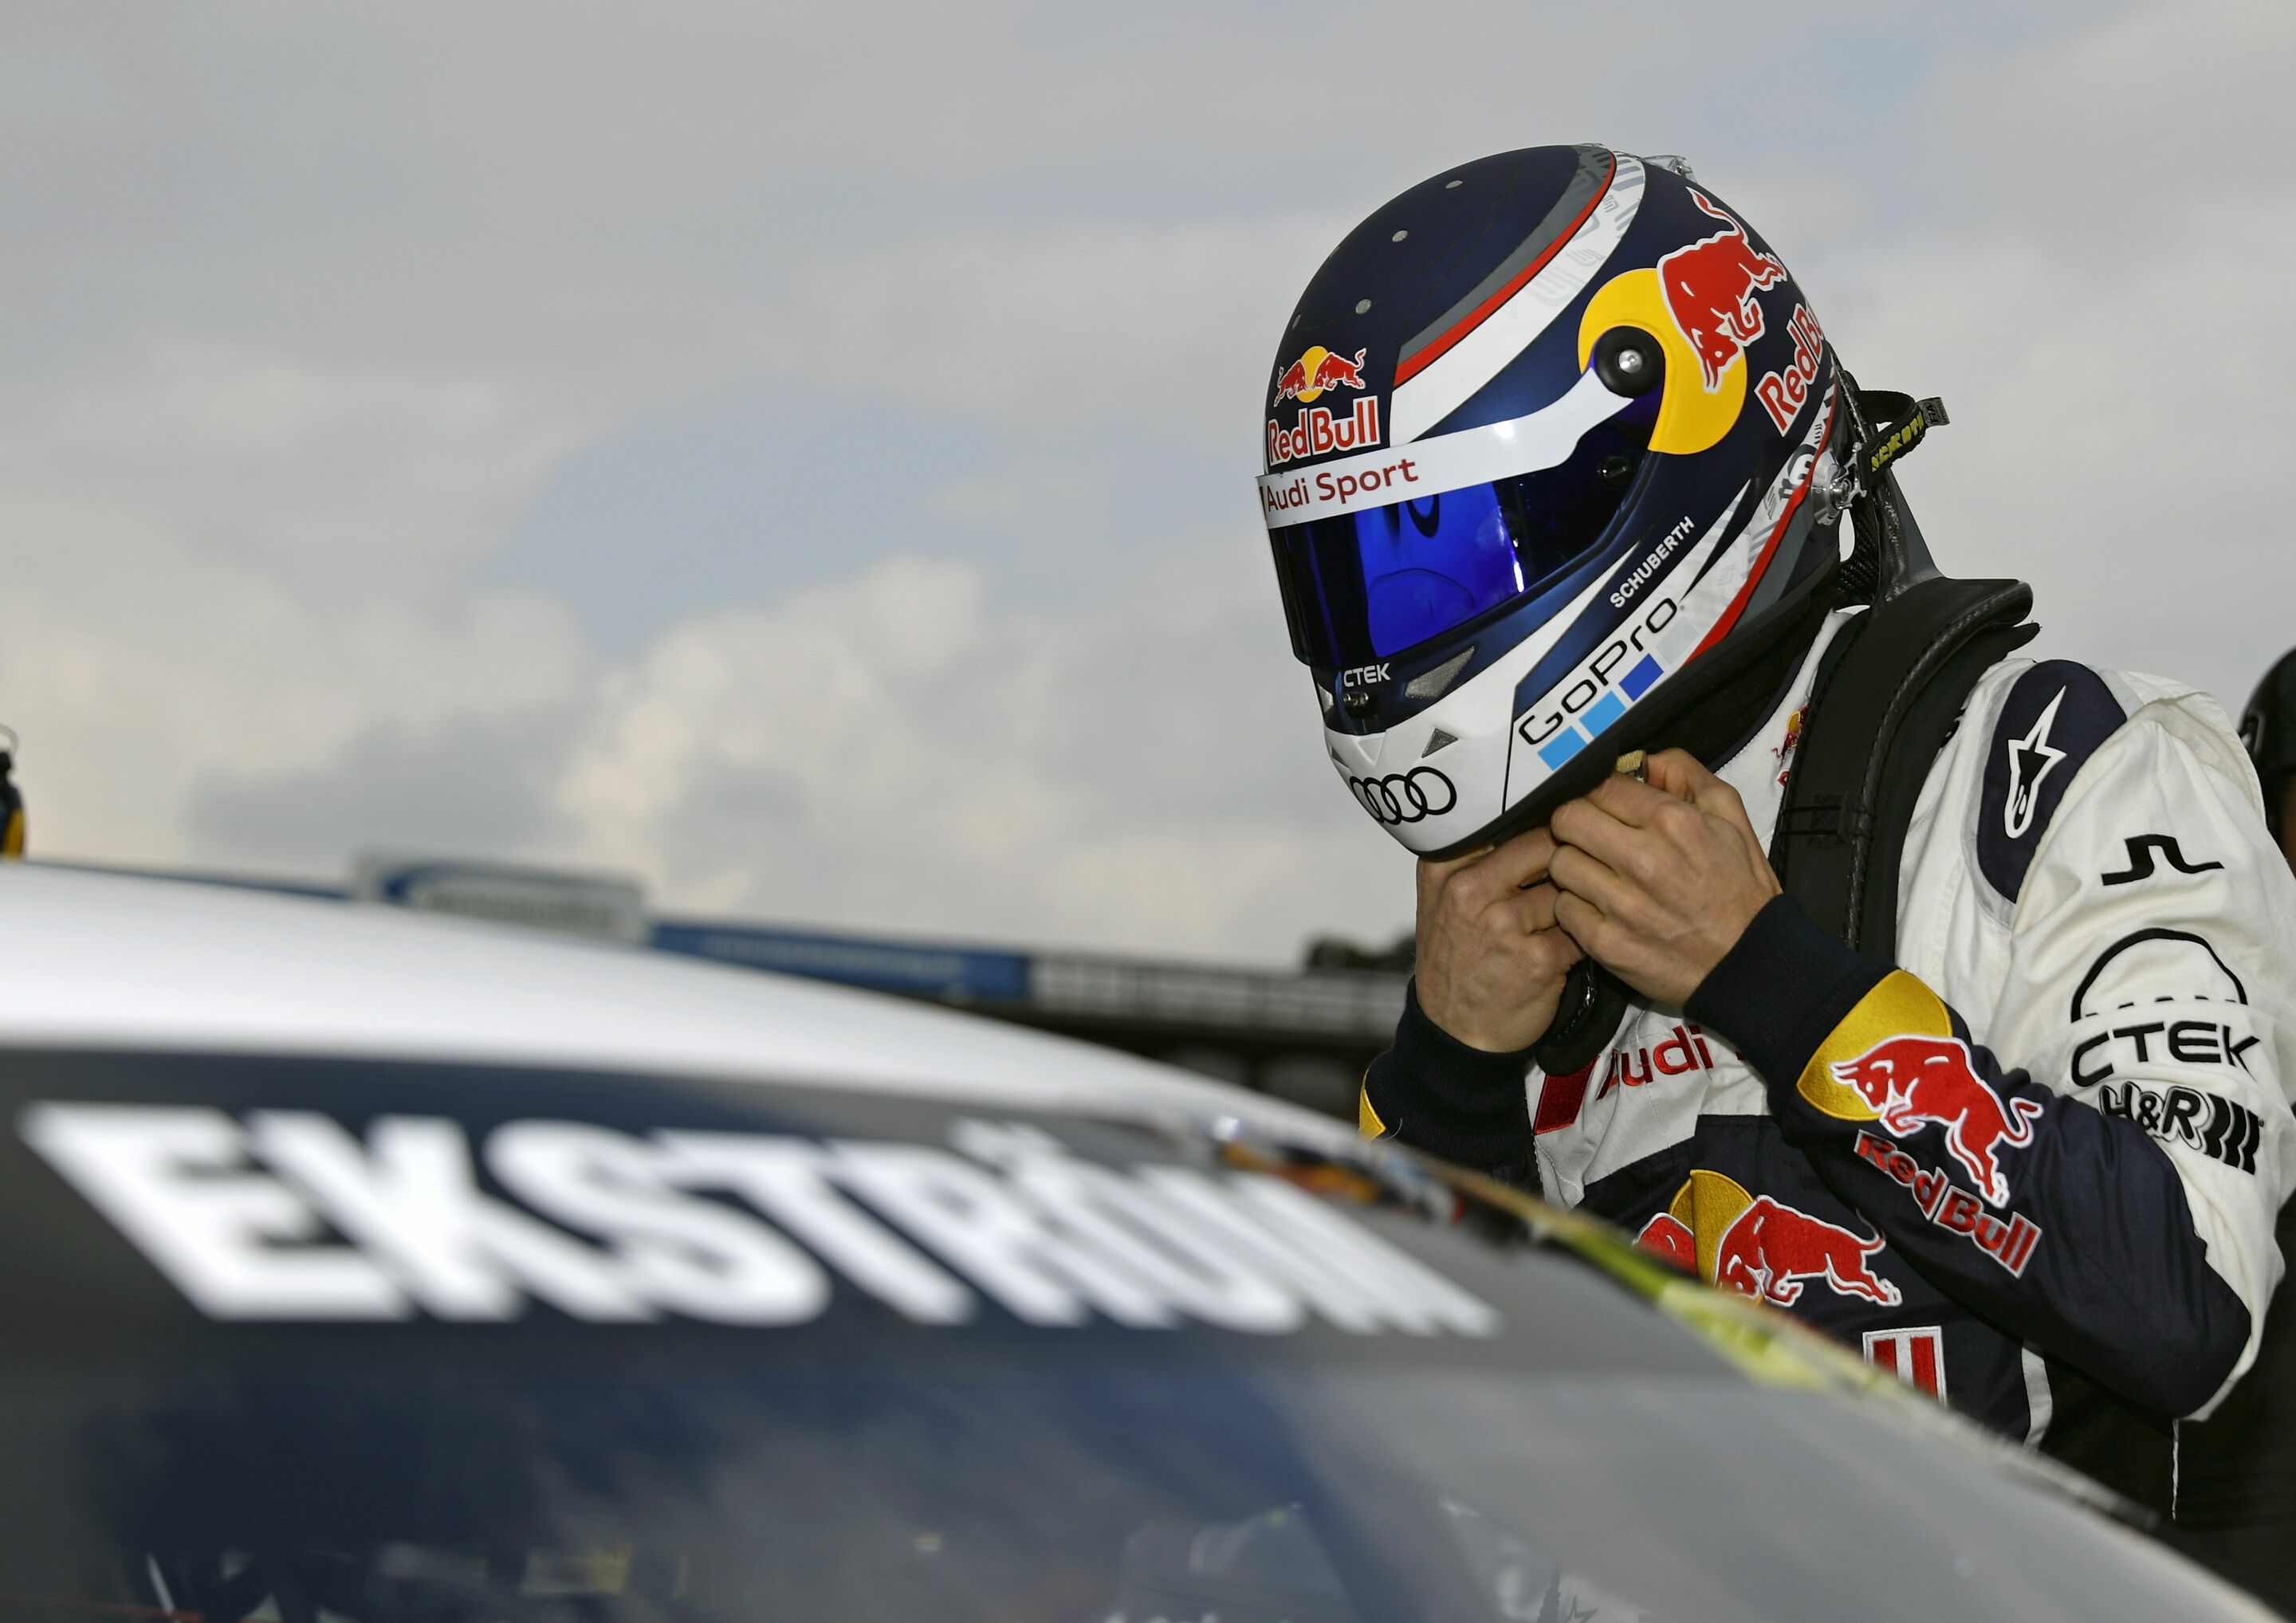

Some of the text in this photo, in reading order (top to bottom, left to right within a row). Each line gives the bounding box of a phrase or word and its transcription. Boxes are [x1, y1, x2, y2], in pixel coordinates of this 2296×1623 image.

[1755, 321, 1818, 435] Red
[1268, 396, 1379, 465] Red Bull
[1268, 459, 1418, 512] Audi Sport
[1610, 516, 1695, 608] SCHUBERTH
[1343, 662, 1391, 687] CTEK
[1518, 598, 1677, 745] GoPro
[2071, 1020, 2259, 1087] CTEK
[1854, 1130, 2042, 1278] Red Bull
